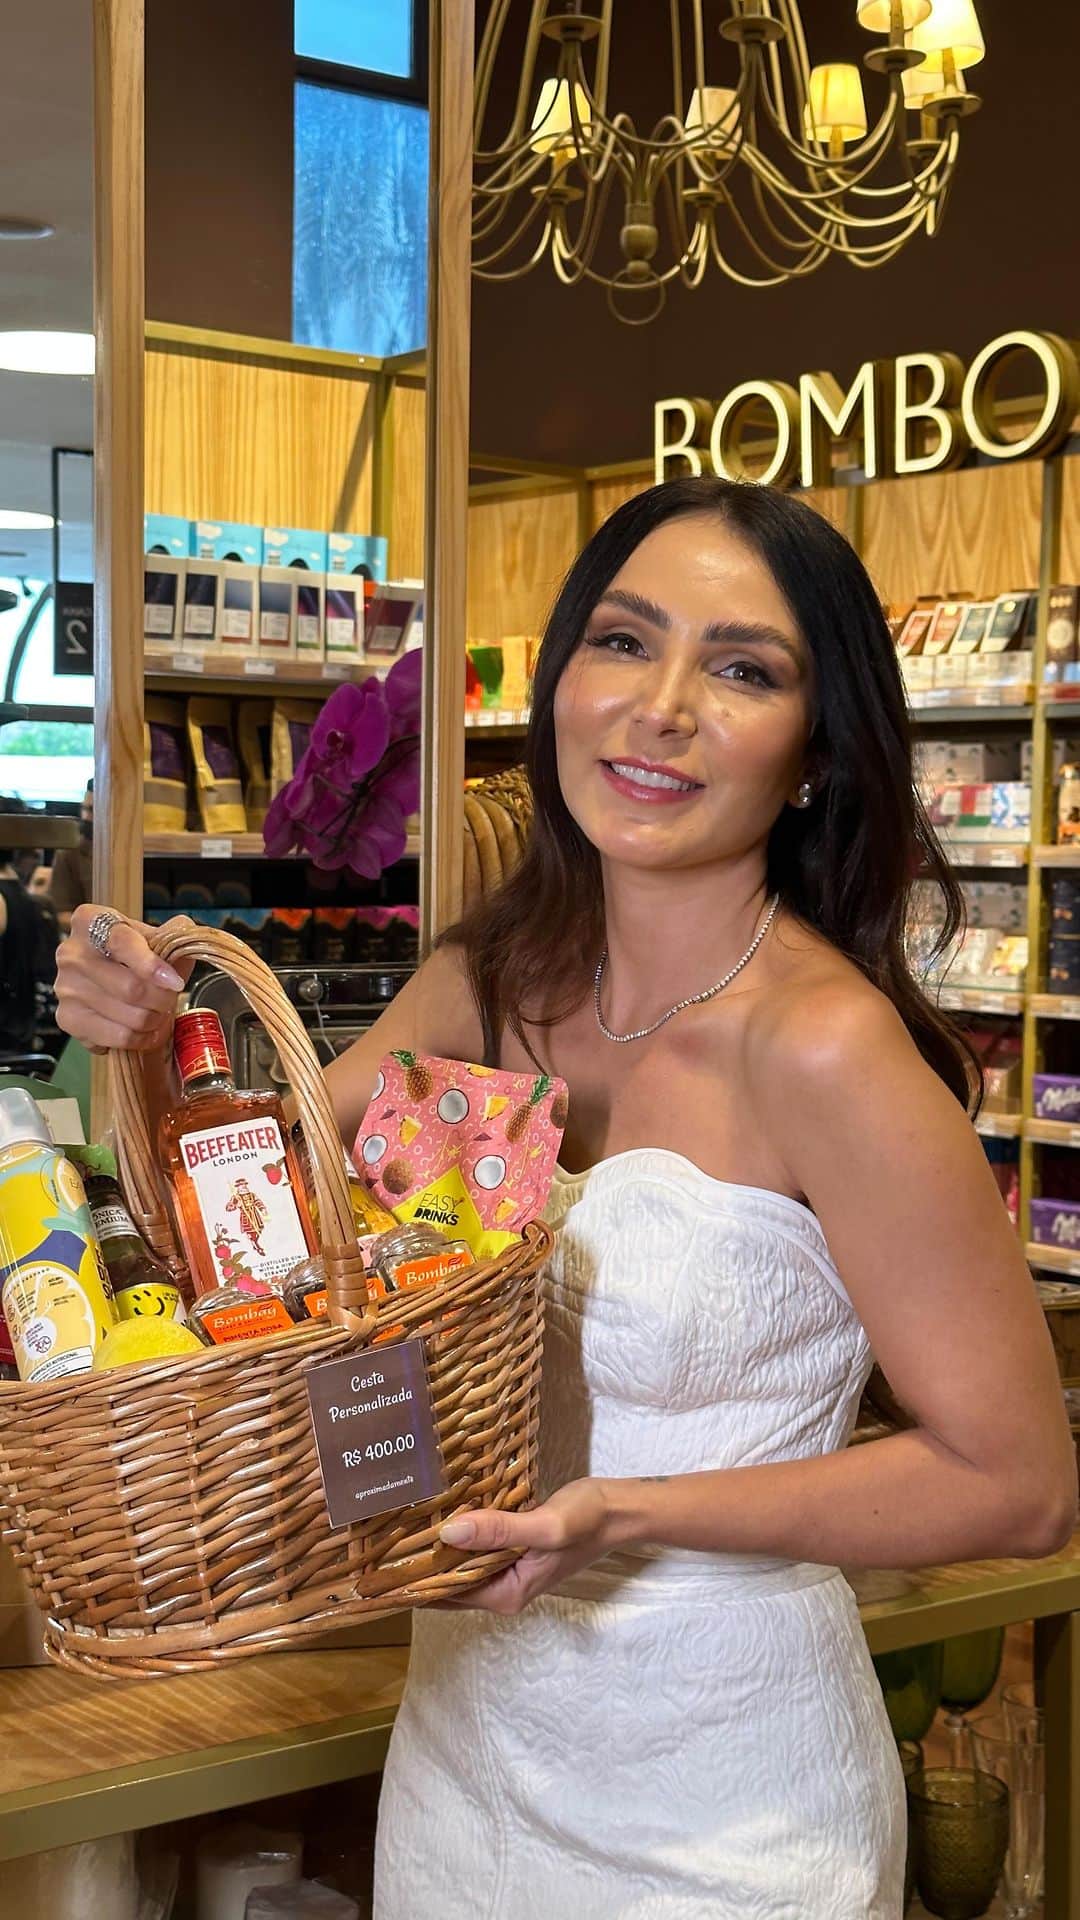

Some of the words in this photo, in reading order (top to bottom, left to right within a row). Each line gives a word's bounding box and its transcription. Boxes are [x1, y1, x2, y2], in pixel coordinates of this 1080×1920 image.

[184, 1126, 280, 1170] BEEFEATER
[213, 1151, 258, 1167] LONDON
[420, 1193, 464, 1213] EASY
[414, 1207, 459, 1226] DRINKS
[213, 1307, 277, 1329] Bombay
[351, 1371, 385, 1393] Cesta
[328, 1386, 414, 1423] Personalizada
[342, 1449, 362, 1469] R$
[364, 1433, 416, 1462] 400.00
[355, 1474, 415, 1501] aproximadamente
